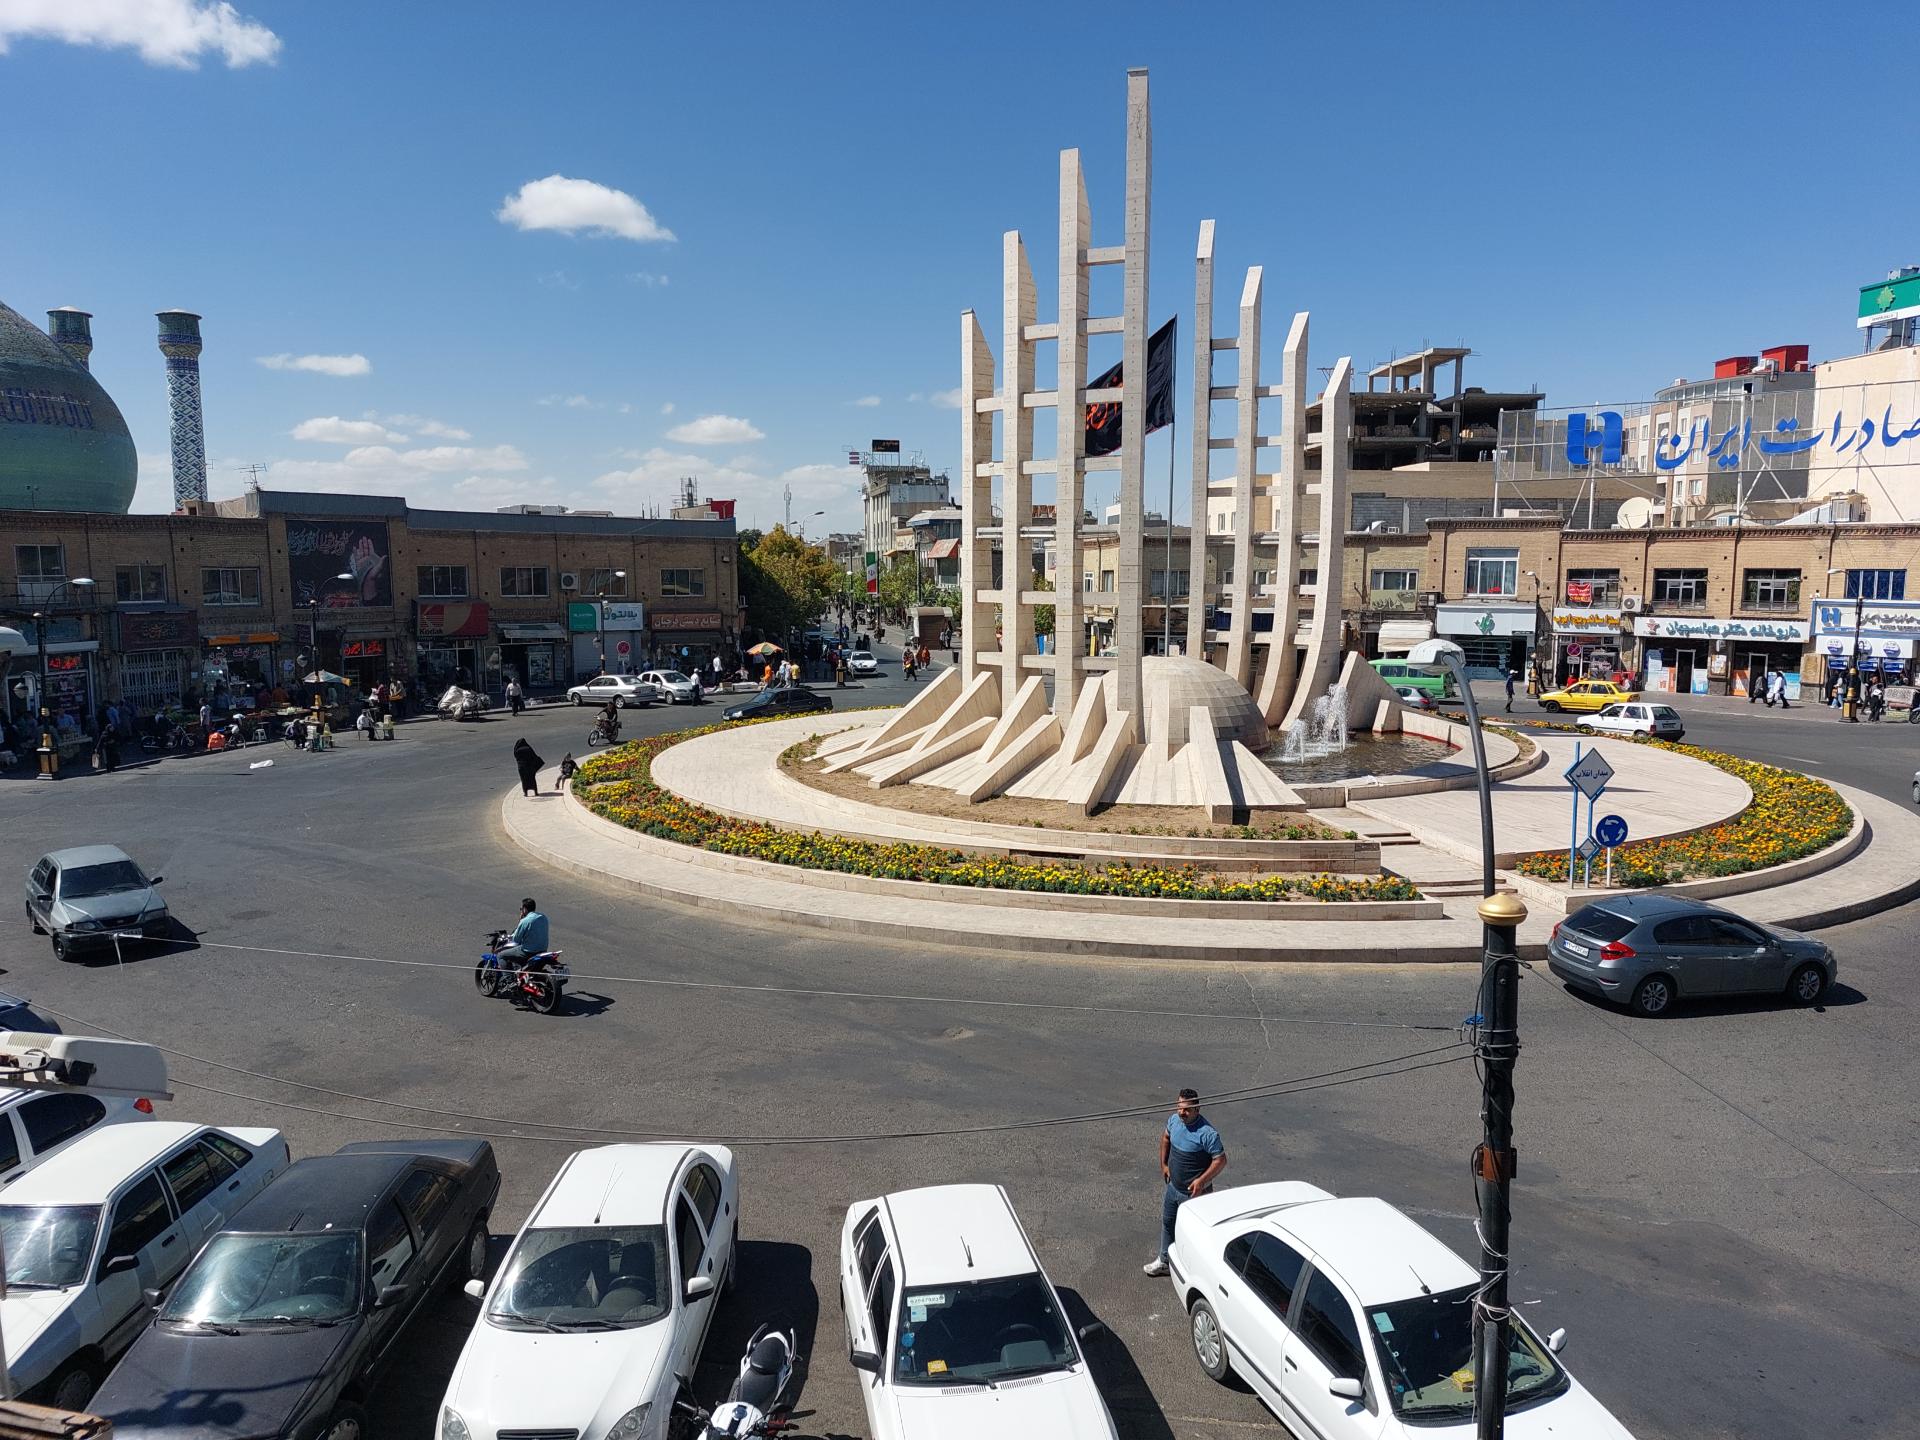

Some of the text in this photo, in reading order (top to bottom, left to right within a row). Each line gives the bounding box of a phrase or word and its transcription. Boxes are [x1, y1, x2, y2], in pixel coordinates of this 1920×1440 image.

[1655, 415, 1752, 470] ایران
[680, 615, 699, 627] دستی
[419, 628, 443, 636] Kodak
[1722, 623, 1747, 637] دکتر
[1749, 621, 1801, 640] داروخانه
[1576, 769, 1608, 779] میدان انقلاب
